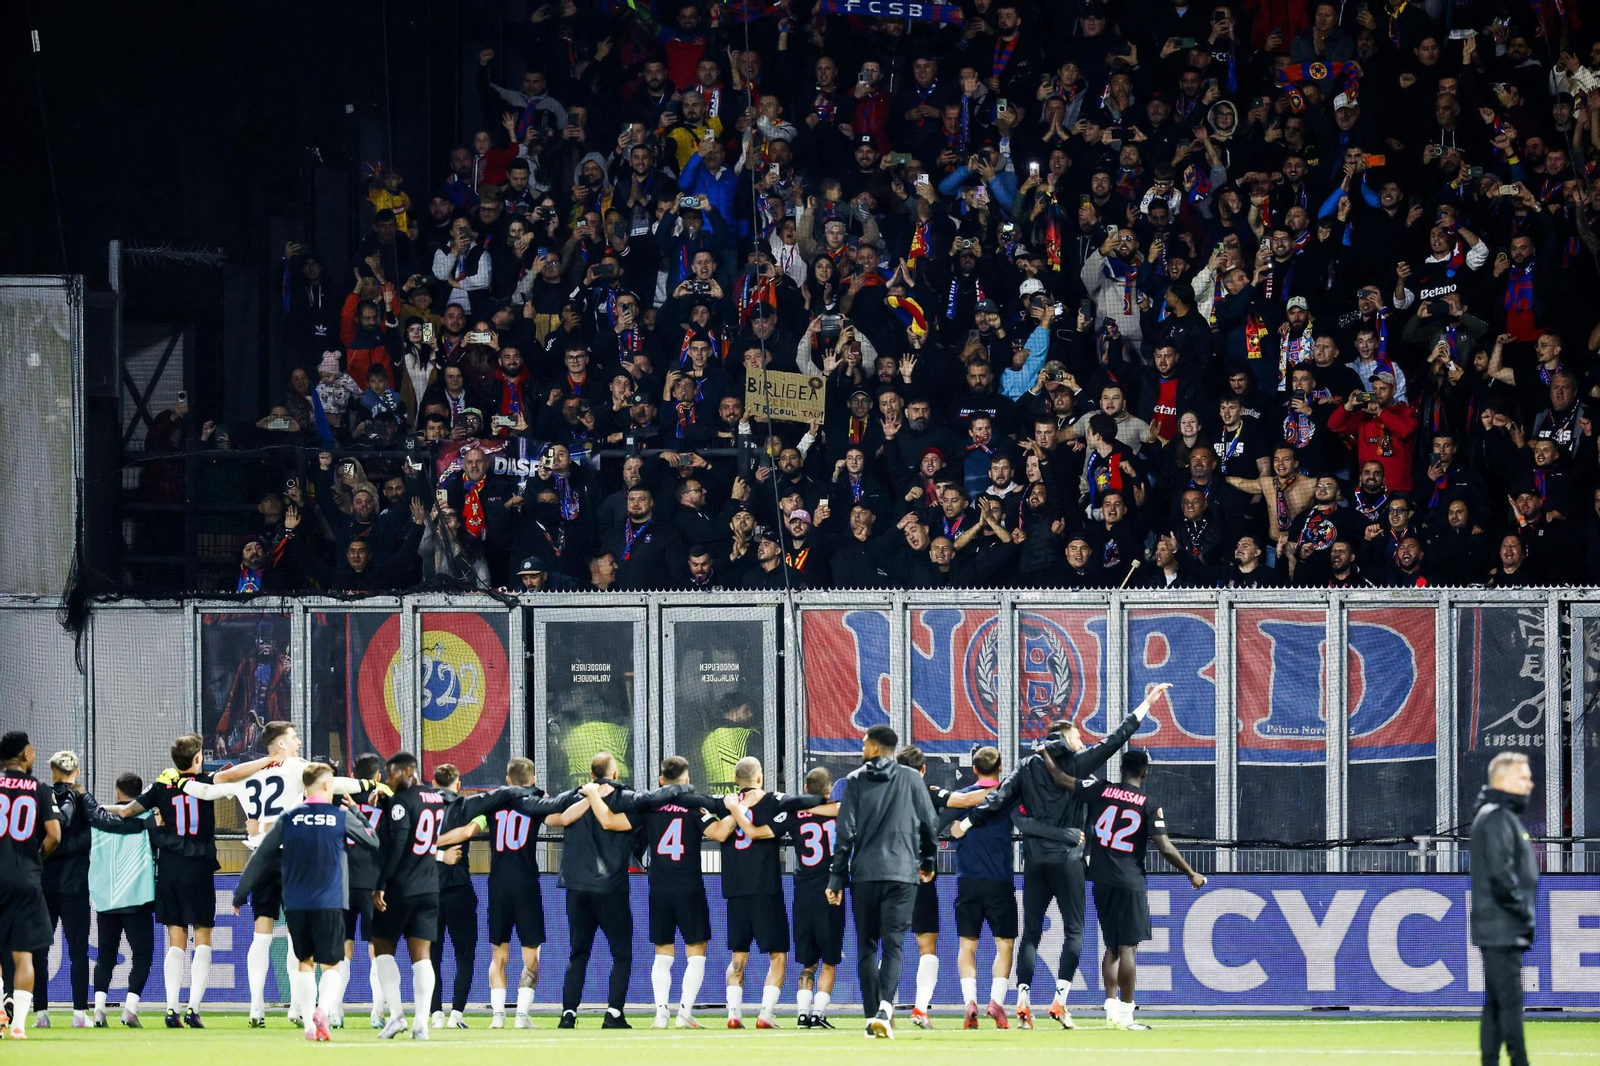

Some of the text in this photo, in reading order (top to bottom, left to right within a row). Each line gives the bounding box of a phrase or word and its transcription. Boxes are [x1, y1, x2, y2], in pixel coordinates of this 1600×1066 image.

[844, 0, 923, 17] FCSB
[1420, 283, 1457, 299] Betano
[1153, 404, 1177, 416] etan
[494, 456, 540, 477] DIASP
[1266, 724, 1299, 735] Peluza
[246, 775, 285, 820] 32
[1101, 787, 1147, 806] ALHASSAN
[172, 794, 198, 836] 11
[292, 814, 336, 827] FCSB
[495, 809, 531, 852] 10
[1095, 805, 1142, 852] 42
[657, 818, 684, 861] 4
[800, 819, 837, 867] 31
